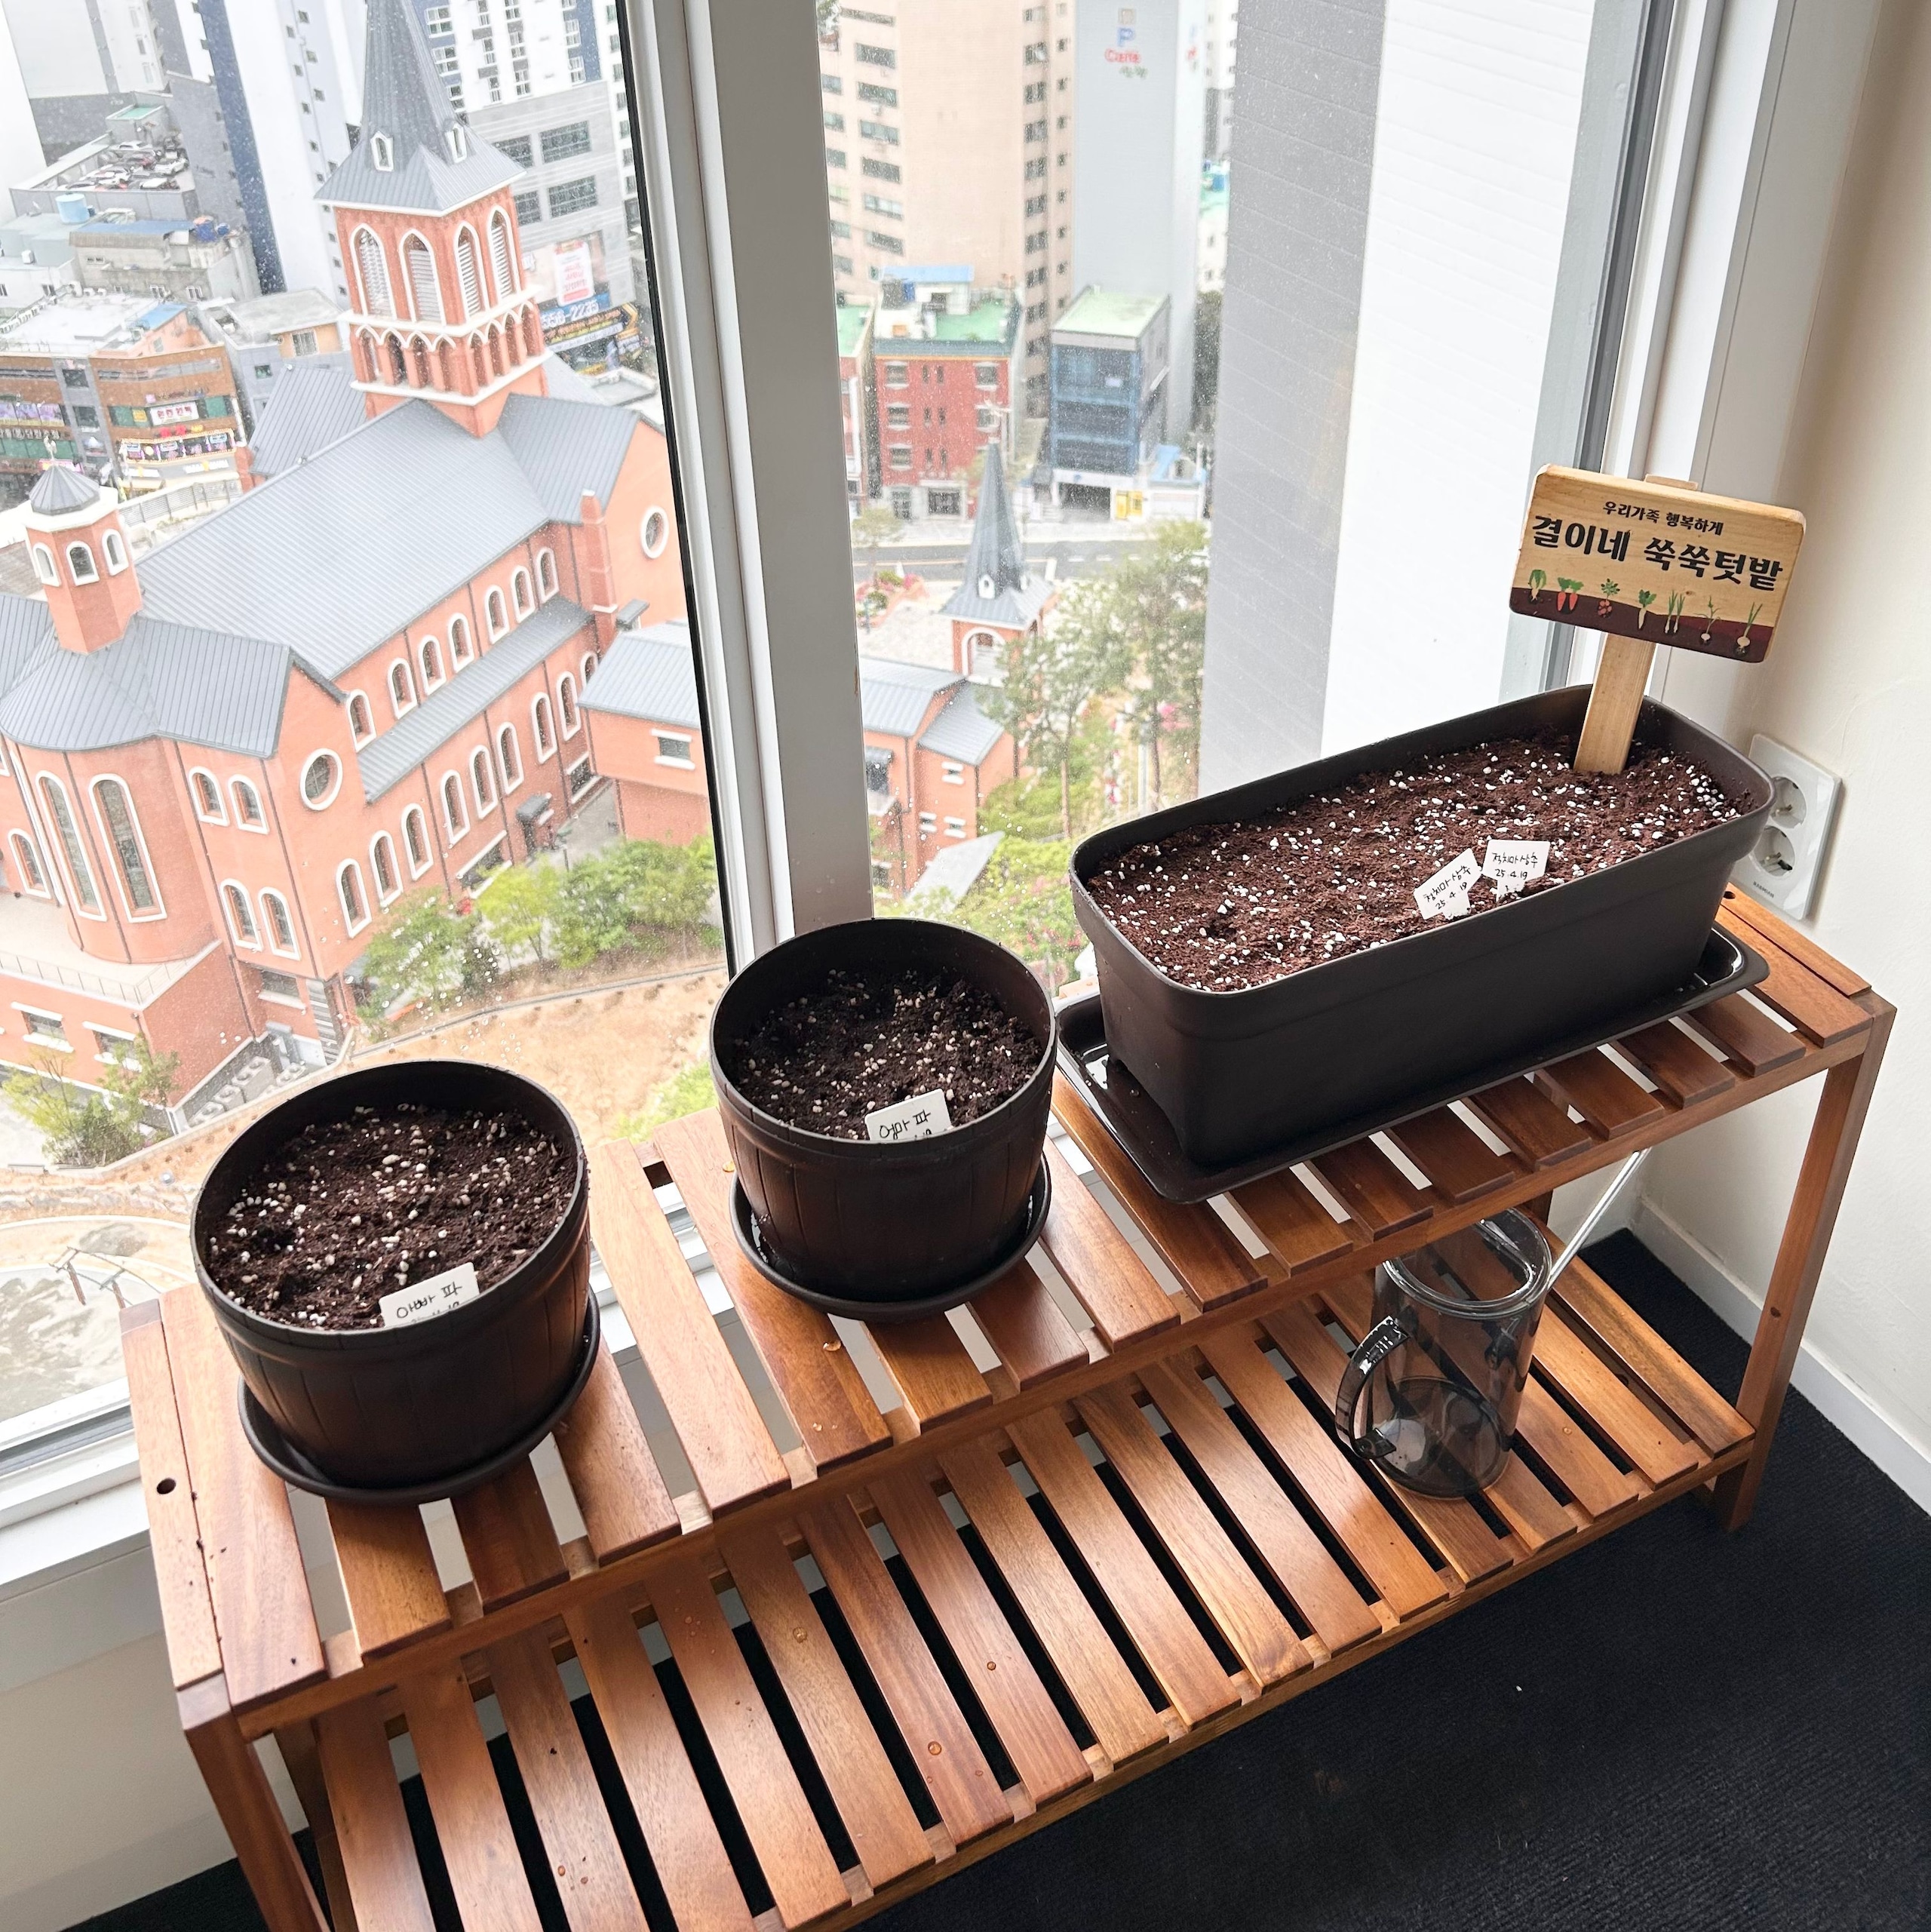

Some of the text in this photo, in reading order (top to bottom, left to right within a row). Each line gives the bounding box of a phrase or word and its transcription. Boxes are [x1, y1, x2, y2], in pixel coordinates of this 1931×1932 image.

[1602, 500, 1724, 536] 우리가족 행복하게
[1531, 514, 1783, 591] 결이네 쑥쑥텃밭
[396, 1295, 435, 1318] 아빠
[441, 1281, 462, 1298] 파
